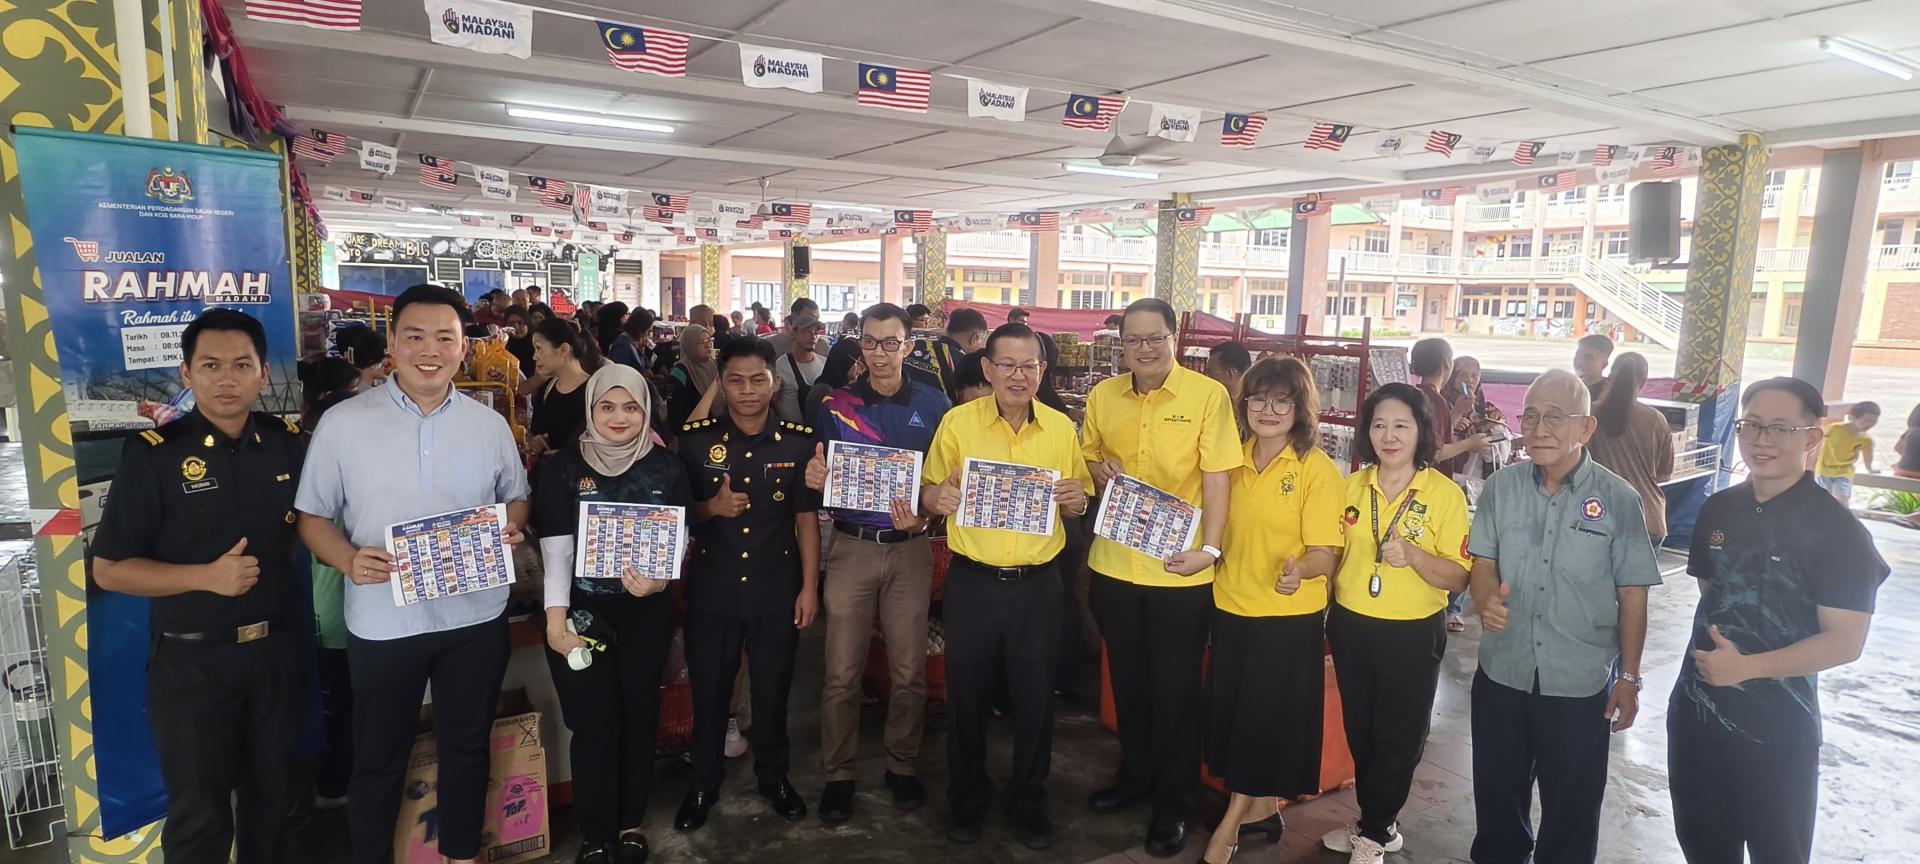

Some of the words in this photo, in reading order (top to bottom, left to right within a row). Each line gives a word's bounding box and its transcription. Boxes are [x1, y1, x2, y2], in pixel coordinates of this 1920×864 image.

[462, 14, 514, 30] MALAYSIA
[462, 22, 515, 39] MADANI
[768, 59, 808, 70] MALAYSIA
[768, 66, 809, 78] MADANI
[349, 247, 361, 257] TO
[406, 240, 430, 257] BIG
[104, 250, 165, 263] JUALAN
[83, 270, 269, 302] RAHMAH
[215, 294, 264, 303] MADANI
[120, 309, 177, 326] Rahmah
[179, 309, 198, 324] itu
[125, 333, 148, 342] Tarikh
[126, 345, 146, 353] Masa
[128, 355, 154, 366] Tempat
[162, 353, 178, 362] SMK
[503, 799, 525, 818] TOP
